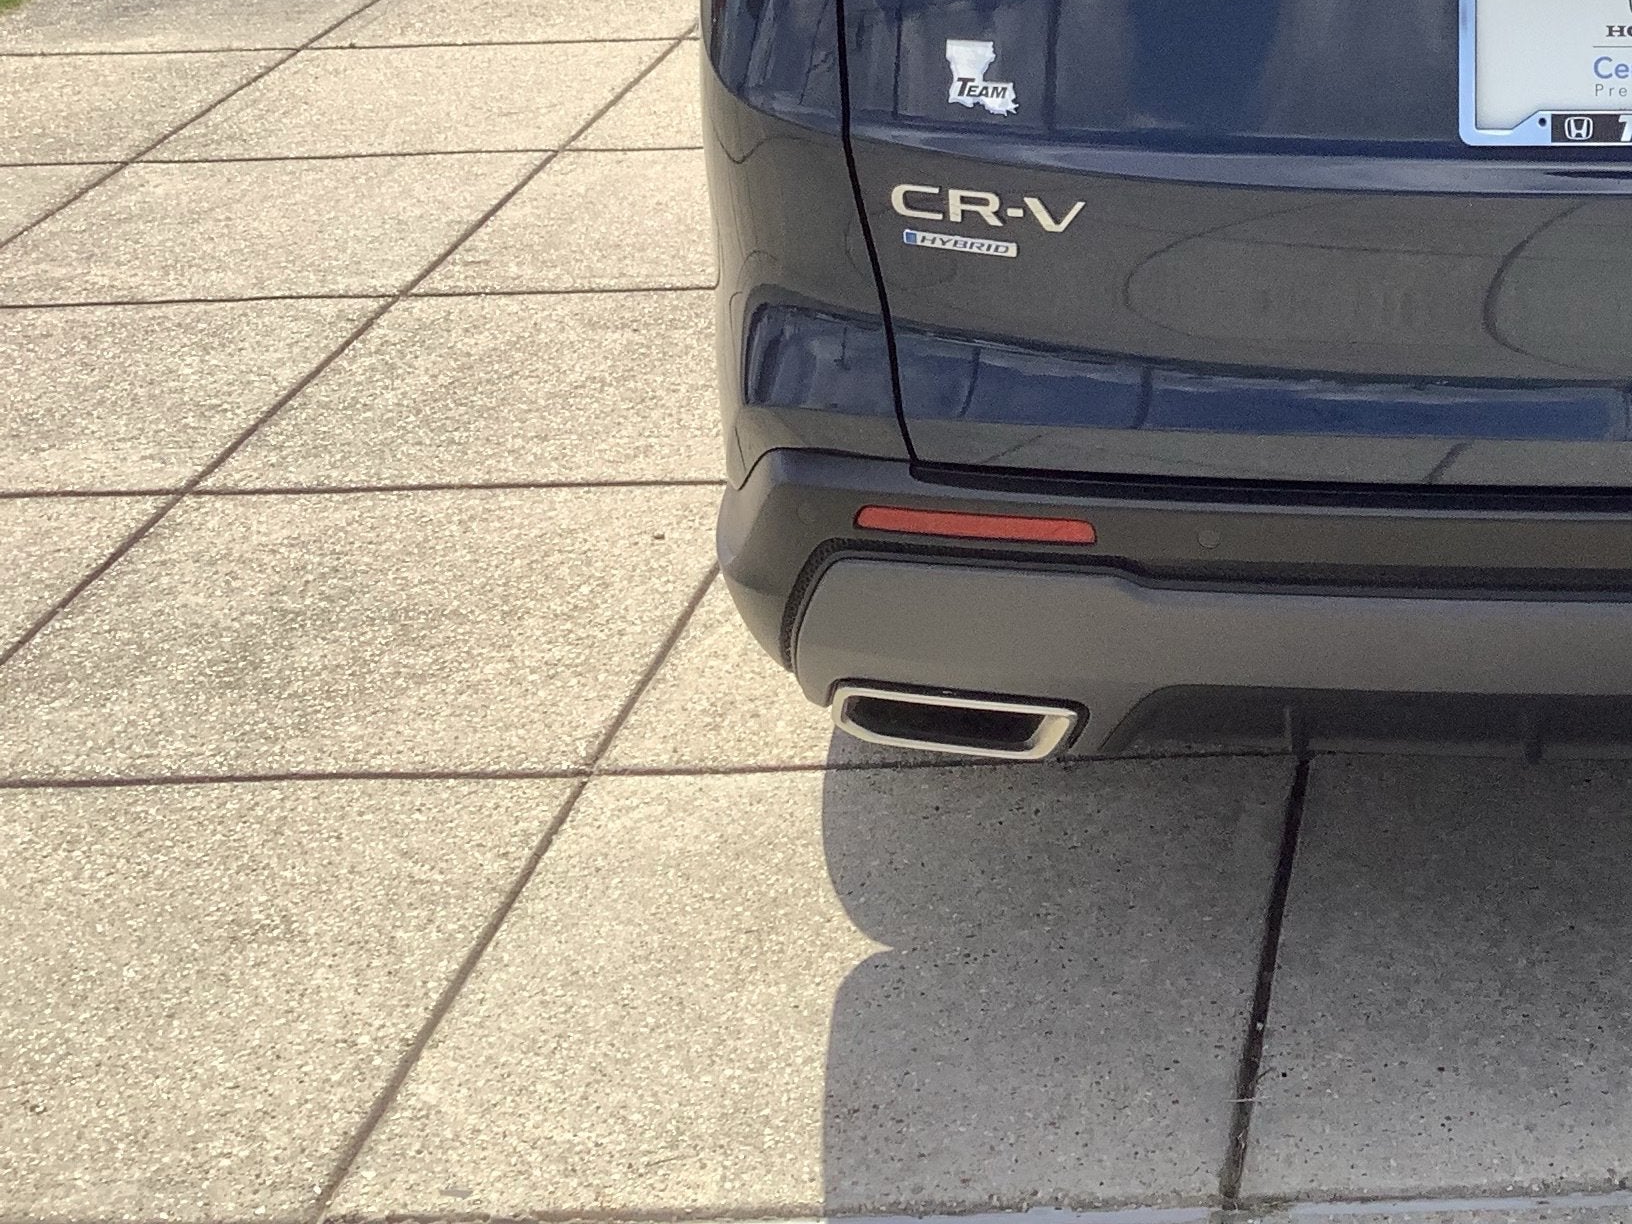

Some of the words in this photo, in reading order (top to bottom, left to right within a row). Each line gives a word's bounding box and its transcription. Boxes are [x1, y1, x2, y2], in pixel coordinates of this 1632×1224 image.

[956, 77, 1008, 99] TEAM
[890, 183, 1087, 233] CR-V
[920, 235, 1010, 254] HYBRID
